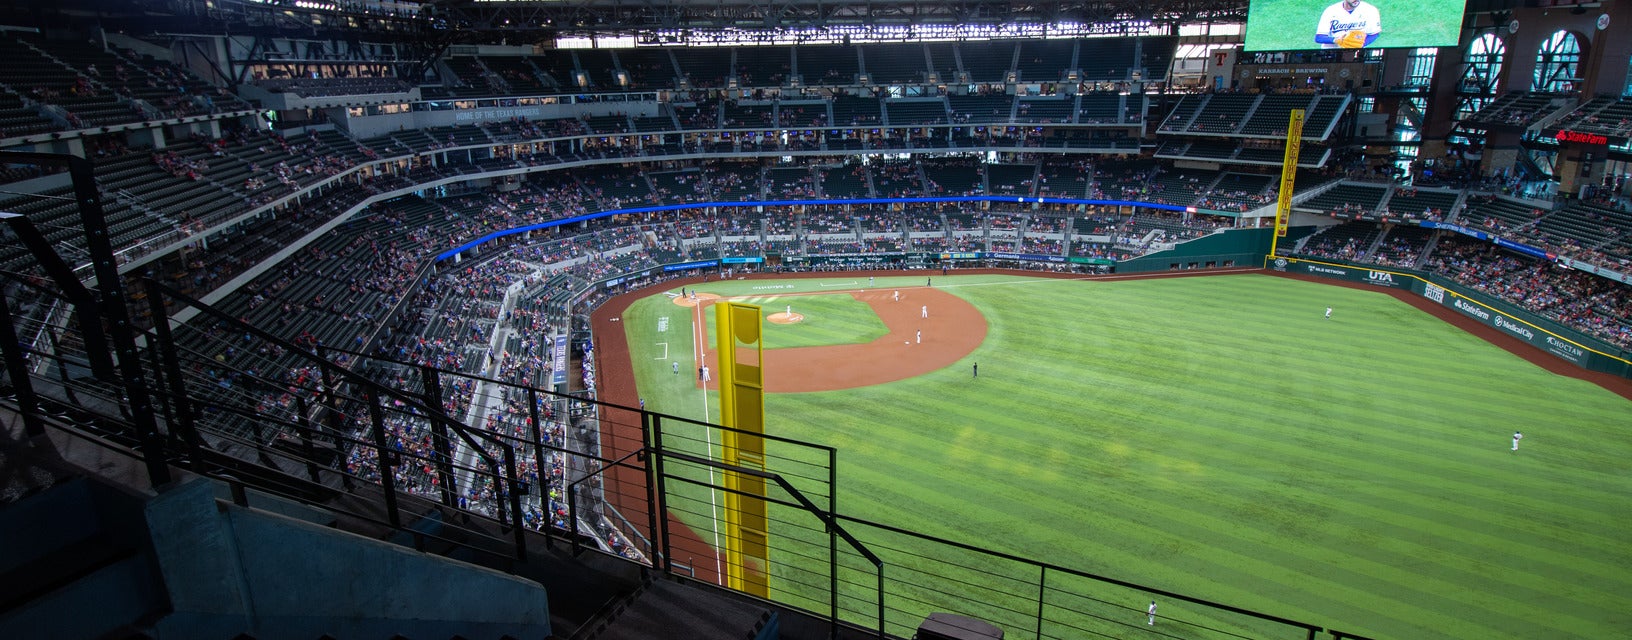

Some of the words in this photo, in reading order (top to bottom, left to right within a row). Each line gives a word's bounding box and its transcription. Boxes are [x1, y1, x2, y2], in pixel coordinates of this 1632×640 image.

[1329, 19, 1367, 33] Rangers
[1214, 52, 1227, 66] T
[456, 111, 474, 121] HOME
[475, 111, 483, 120] OF
[484, 110, 495, 119] THE
[496, 109, 514, 118] TEXAS
[515, 107, 540, 117] RANGERS
[1368, 270, 1393, 282] UTA
[1424, 288, 1445, 304] SELTZER
[1546, 336, 1583, 357] CHOCTAW
